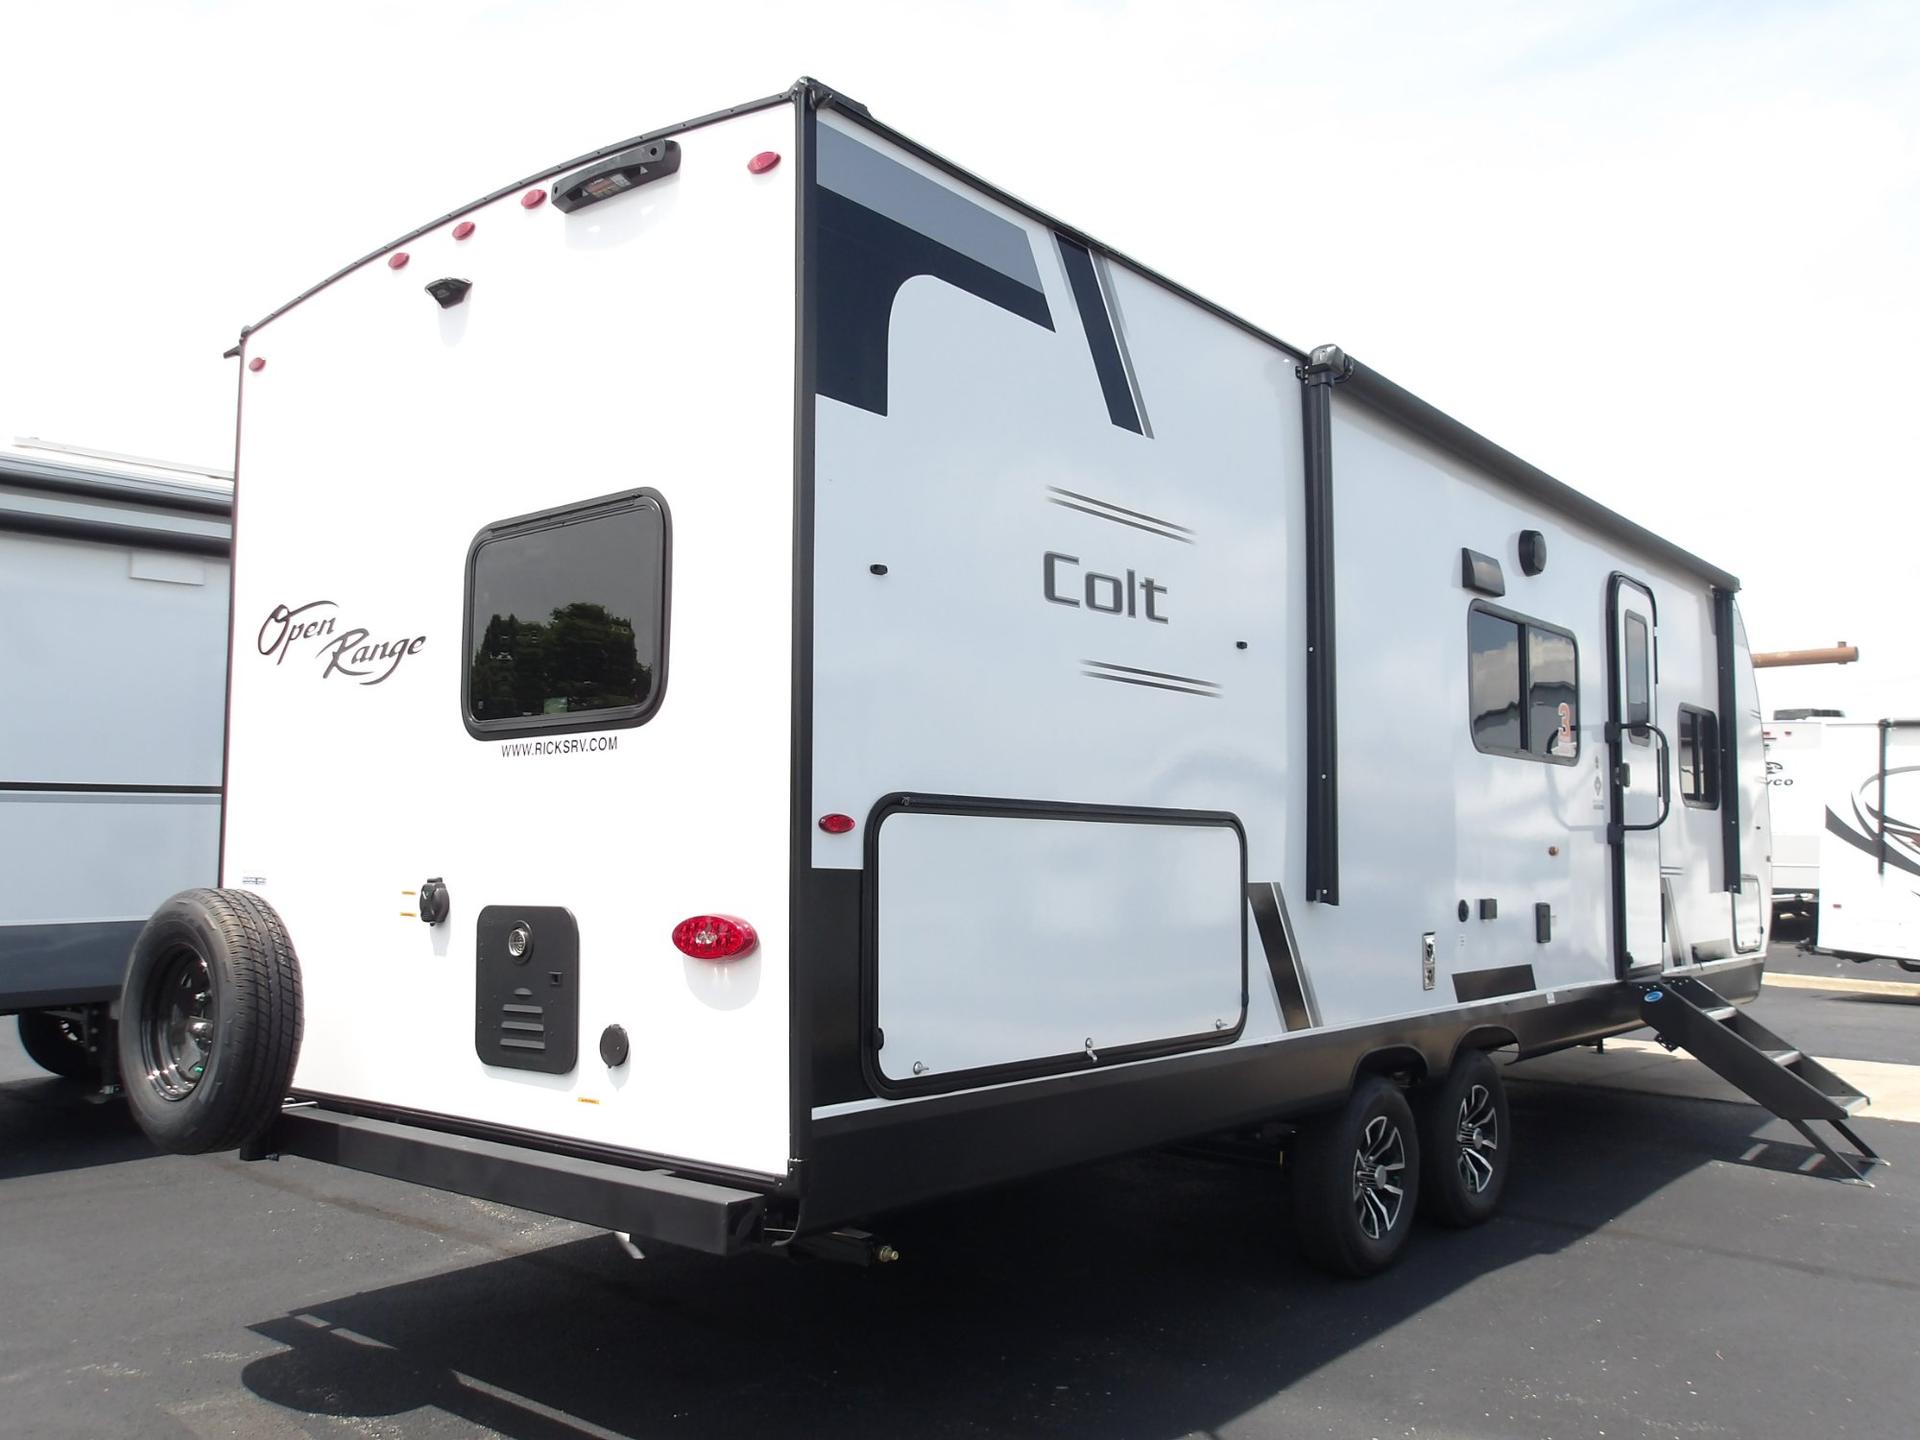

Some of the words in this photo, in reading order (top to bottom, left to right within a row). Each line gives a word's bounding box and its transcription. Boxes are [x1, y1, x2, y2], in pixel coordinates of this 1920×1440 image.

[1043, 550, 1169, 624] Colt
[258, 600, 340, 665] Open
[315, 628, 426, 685] Range
[501, 736, 618, 757] WWW.RICKSRV.COM
